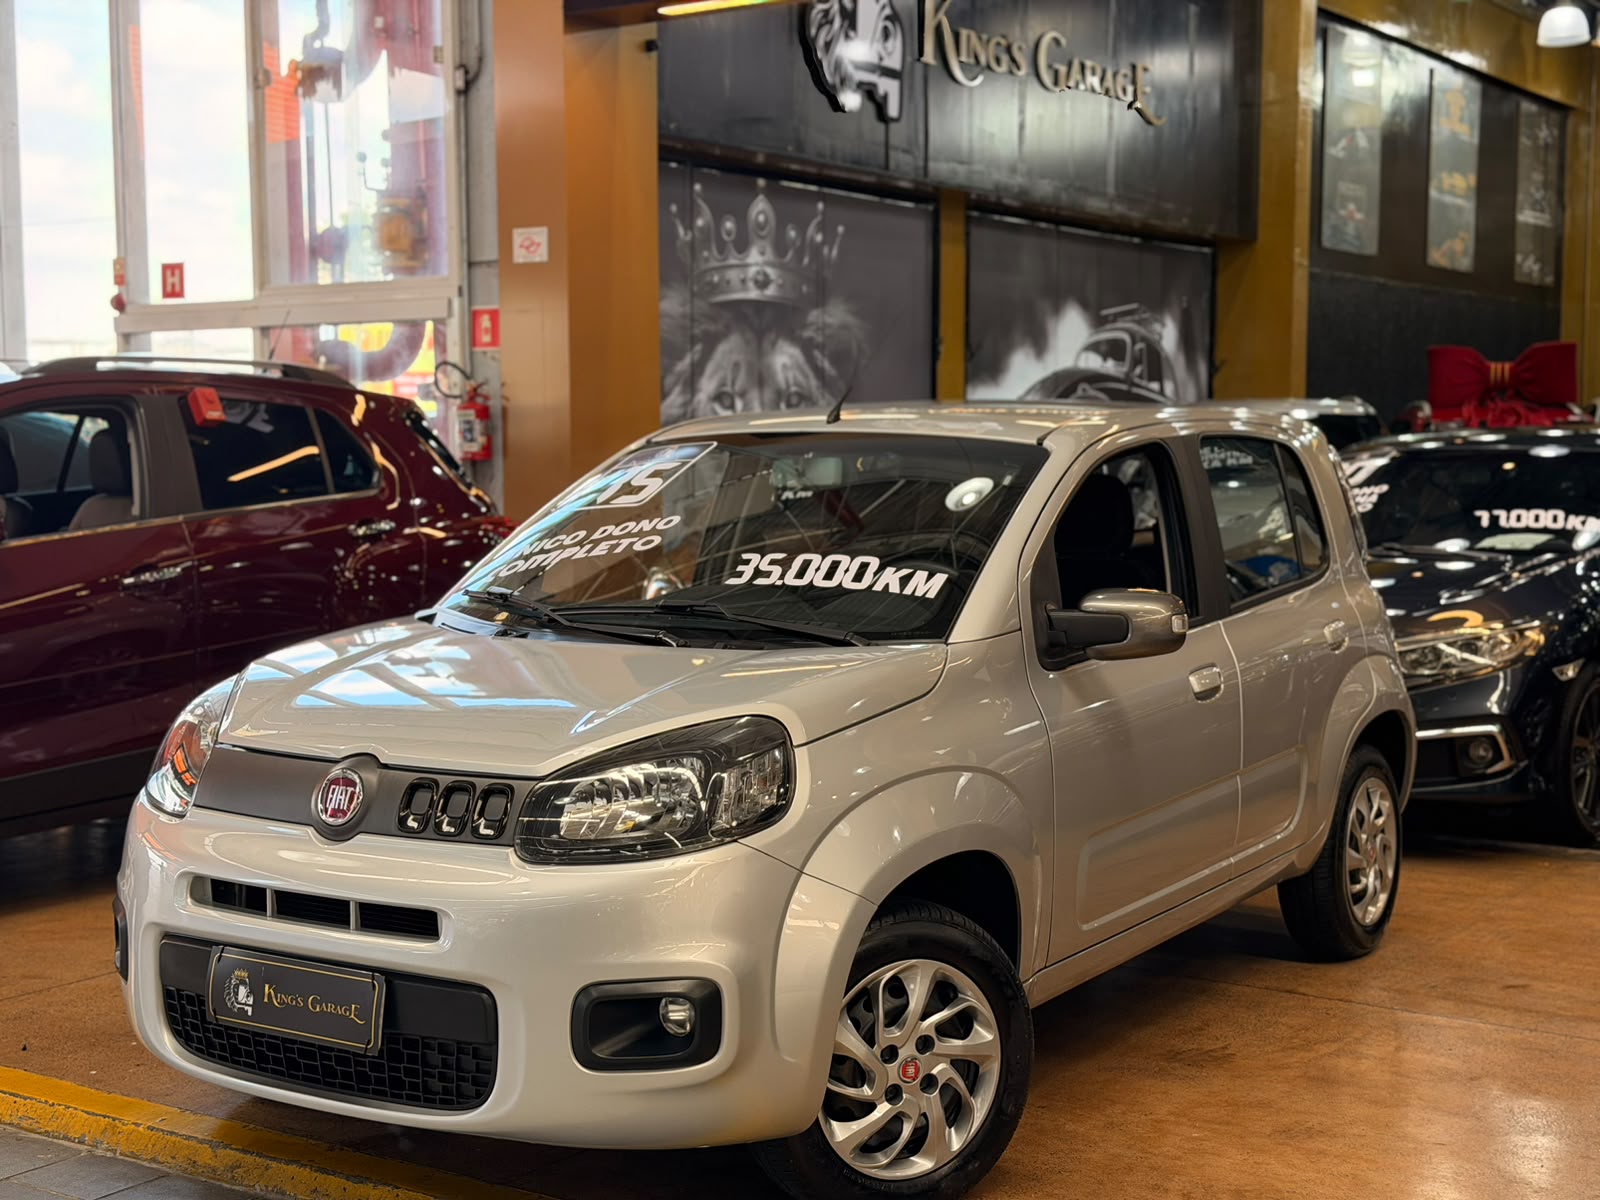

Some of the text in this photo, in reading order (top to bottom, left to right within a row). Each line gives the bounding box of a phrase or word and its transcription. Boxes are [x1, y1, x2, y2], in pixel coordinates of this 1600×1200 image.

[1036, 31, 1167, 126] GARAGE
[166, 268, 180, 293] H
[591, 515, 681, 540] DONO
[326, 785, 355, 810] FIAT
[307, 995, 366, 1025] GARAGE
